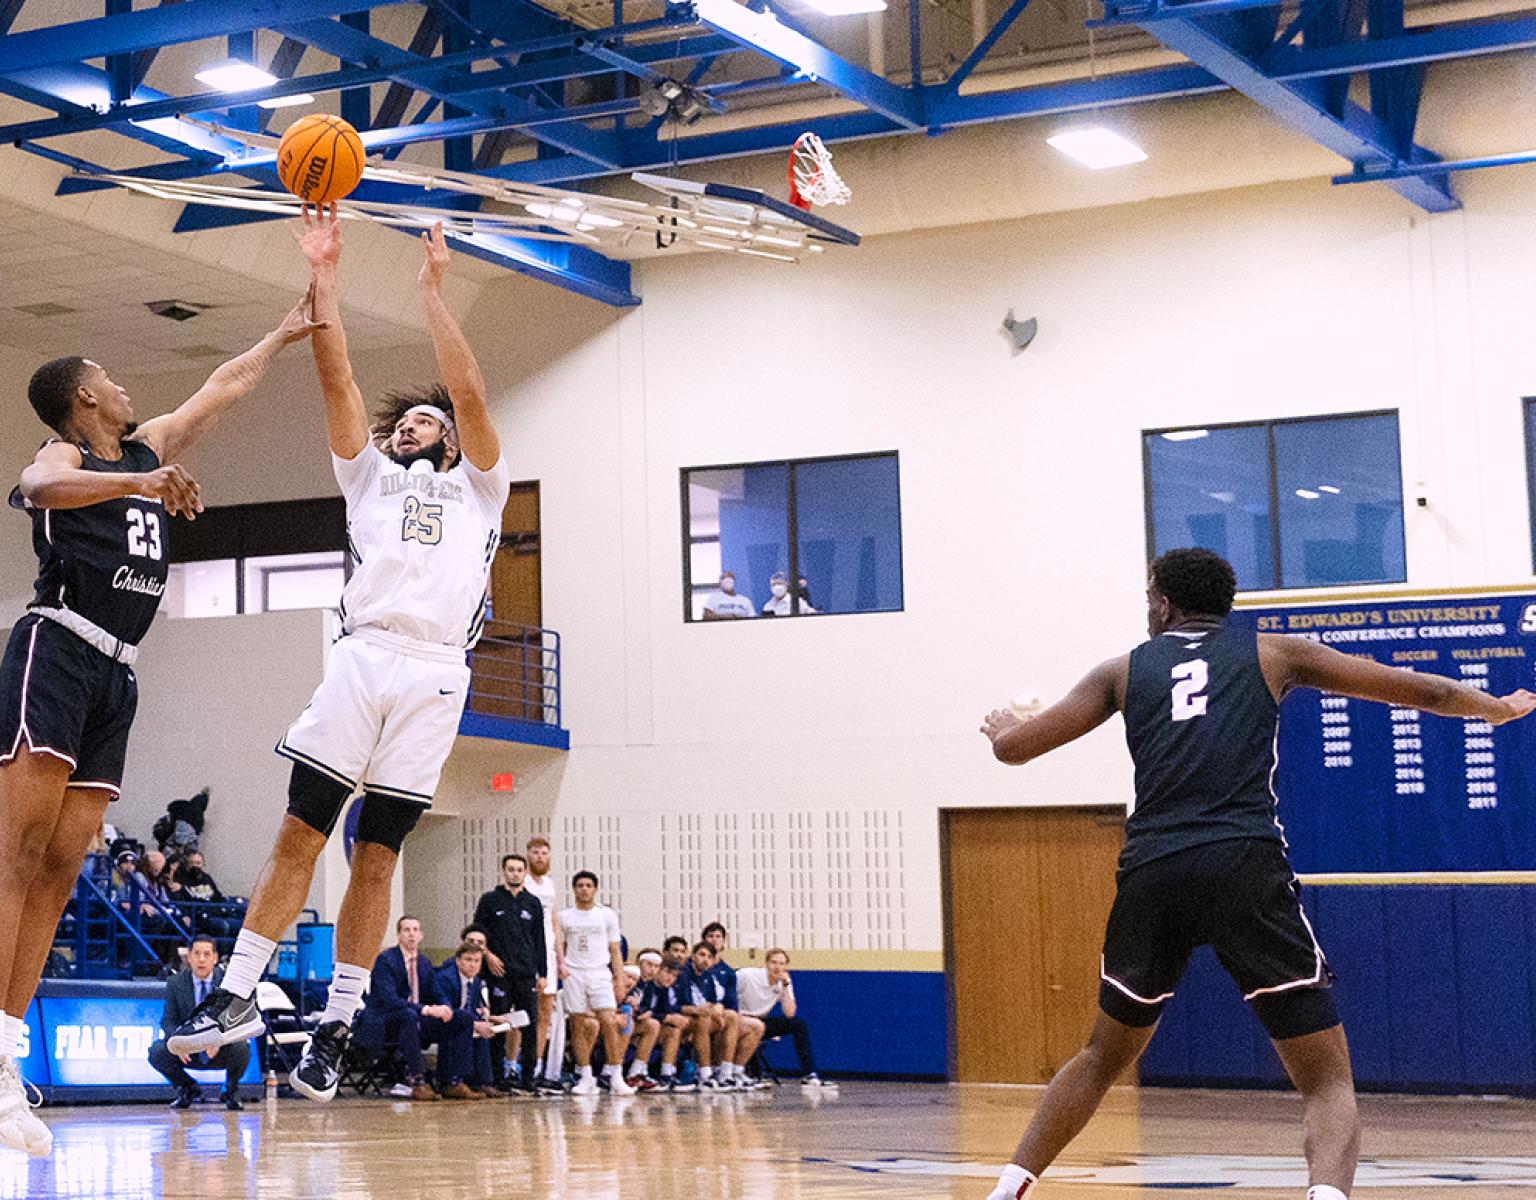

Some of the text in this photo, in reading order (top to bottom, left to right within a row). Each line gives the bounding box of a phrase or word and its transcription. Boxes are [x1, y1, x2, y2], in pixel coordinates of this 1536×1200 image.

[126, 508, 163, 560] 23
[402, 495, 443, 546] 25
[1257, 606, 1500, 630] ST. EDWARD'S UNIVERSITY
[1322, 627, 1415, 643] CONFERENCE
[1419, 623, 1506, 638] CHAMPIONS
[1393, 650, 1438, 662] SOCCER
[1452, 647, 1526, 659] VOLLEYBALL
[1172, 659, 1208, 721] 2
[55, 1025, 109, 1060] FEAR
